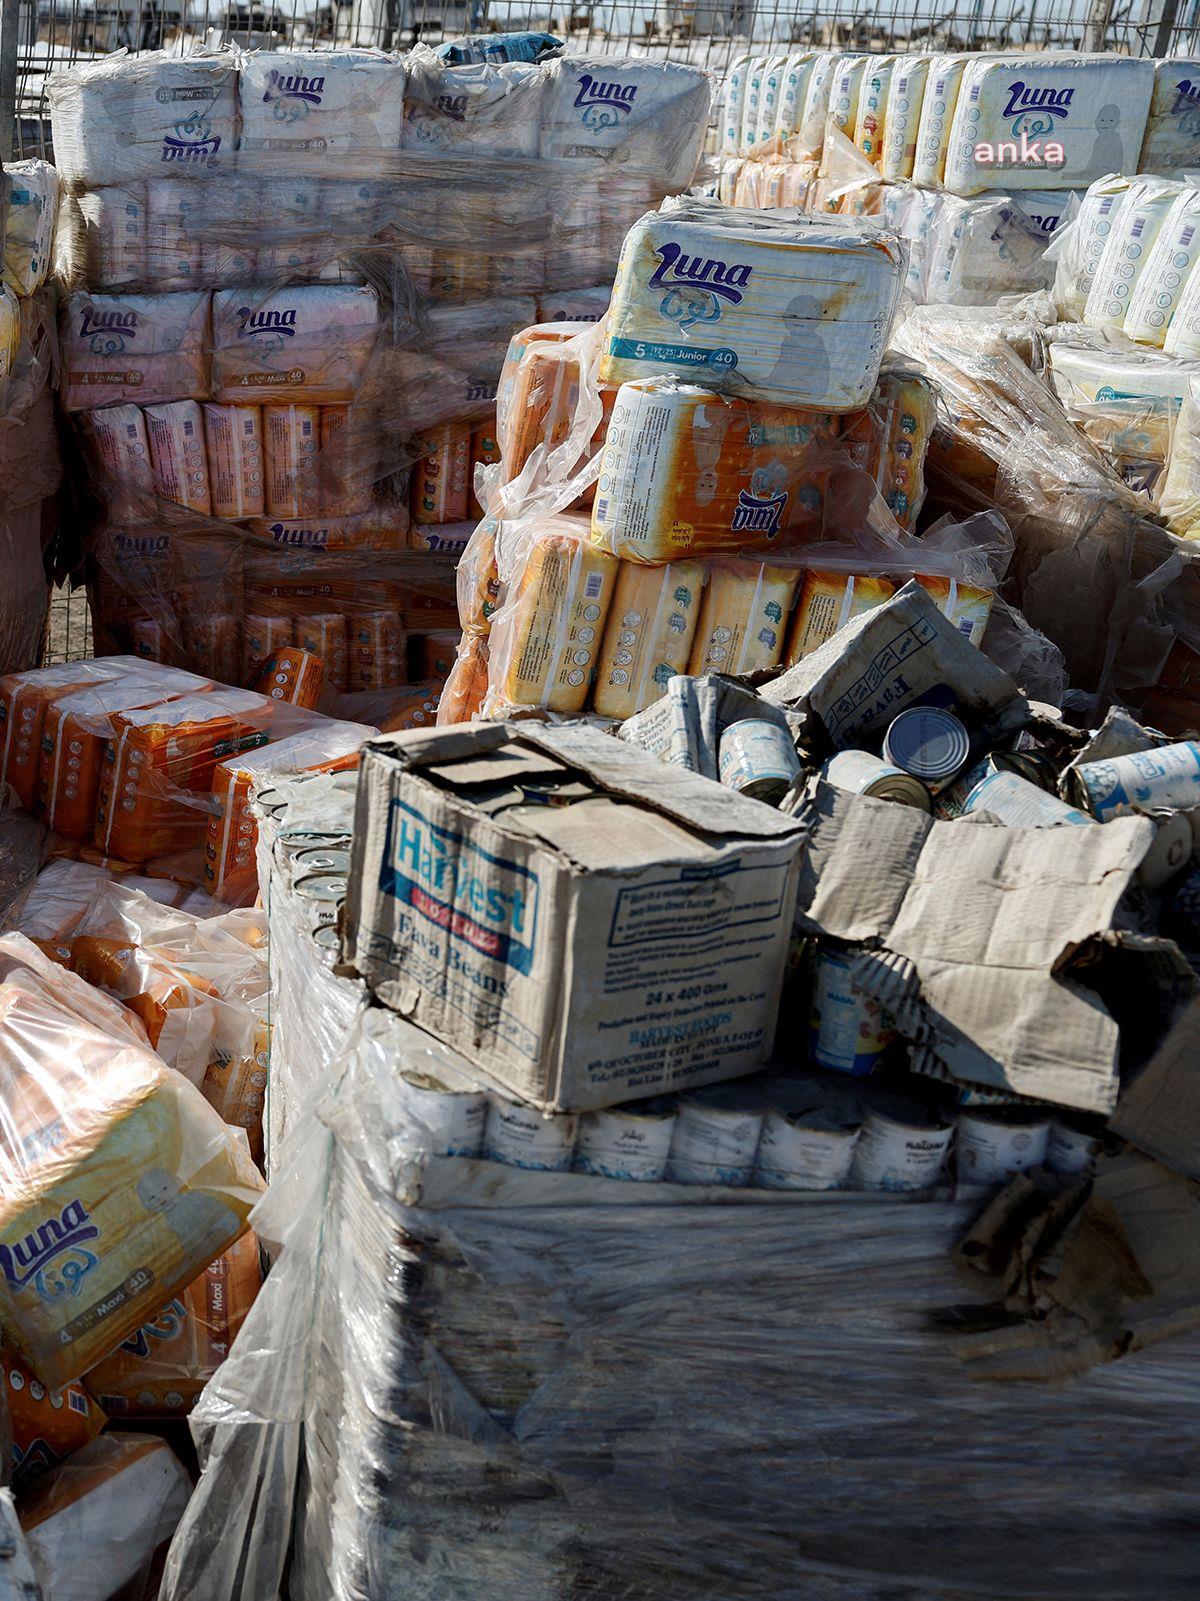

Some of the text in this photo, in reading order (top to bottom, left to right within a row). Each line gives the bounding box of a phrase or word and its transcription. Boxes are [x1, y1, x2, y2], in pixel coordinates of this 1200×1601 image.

[573, 74, 638, 113] Luna
[1003, 81, 1075, 118] Luna
[649, 242, 754, 305] Luna
[80, 306, 137, 338] Luna
[235, 306, 297, 338] Luna
[659, 287, 722, 331] لونا
[635, 344, 646, 357] 5
[677, 350, 708, 362] Junior
[714, 351, 733, 364] 40
[241, 375, 249, 385] 4
[290, 371, 302, 380] 40
[731, 488, 789, 541] Luna
[860, 673, 913, 725] Fava
[397, 817, 526, 934] Harvest
[447, 946, 509, 998] Beans
[646, 991, 662, 1006] 24
[665, 992, 675, 1003] x
[678, 985, 701, 1001] 400
[59, 1270, 147, 1345] 4 Maxi 40
[211, 1283, 224, 1312] Maxi
